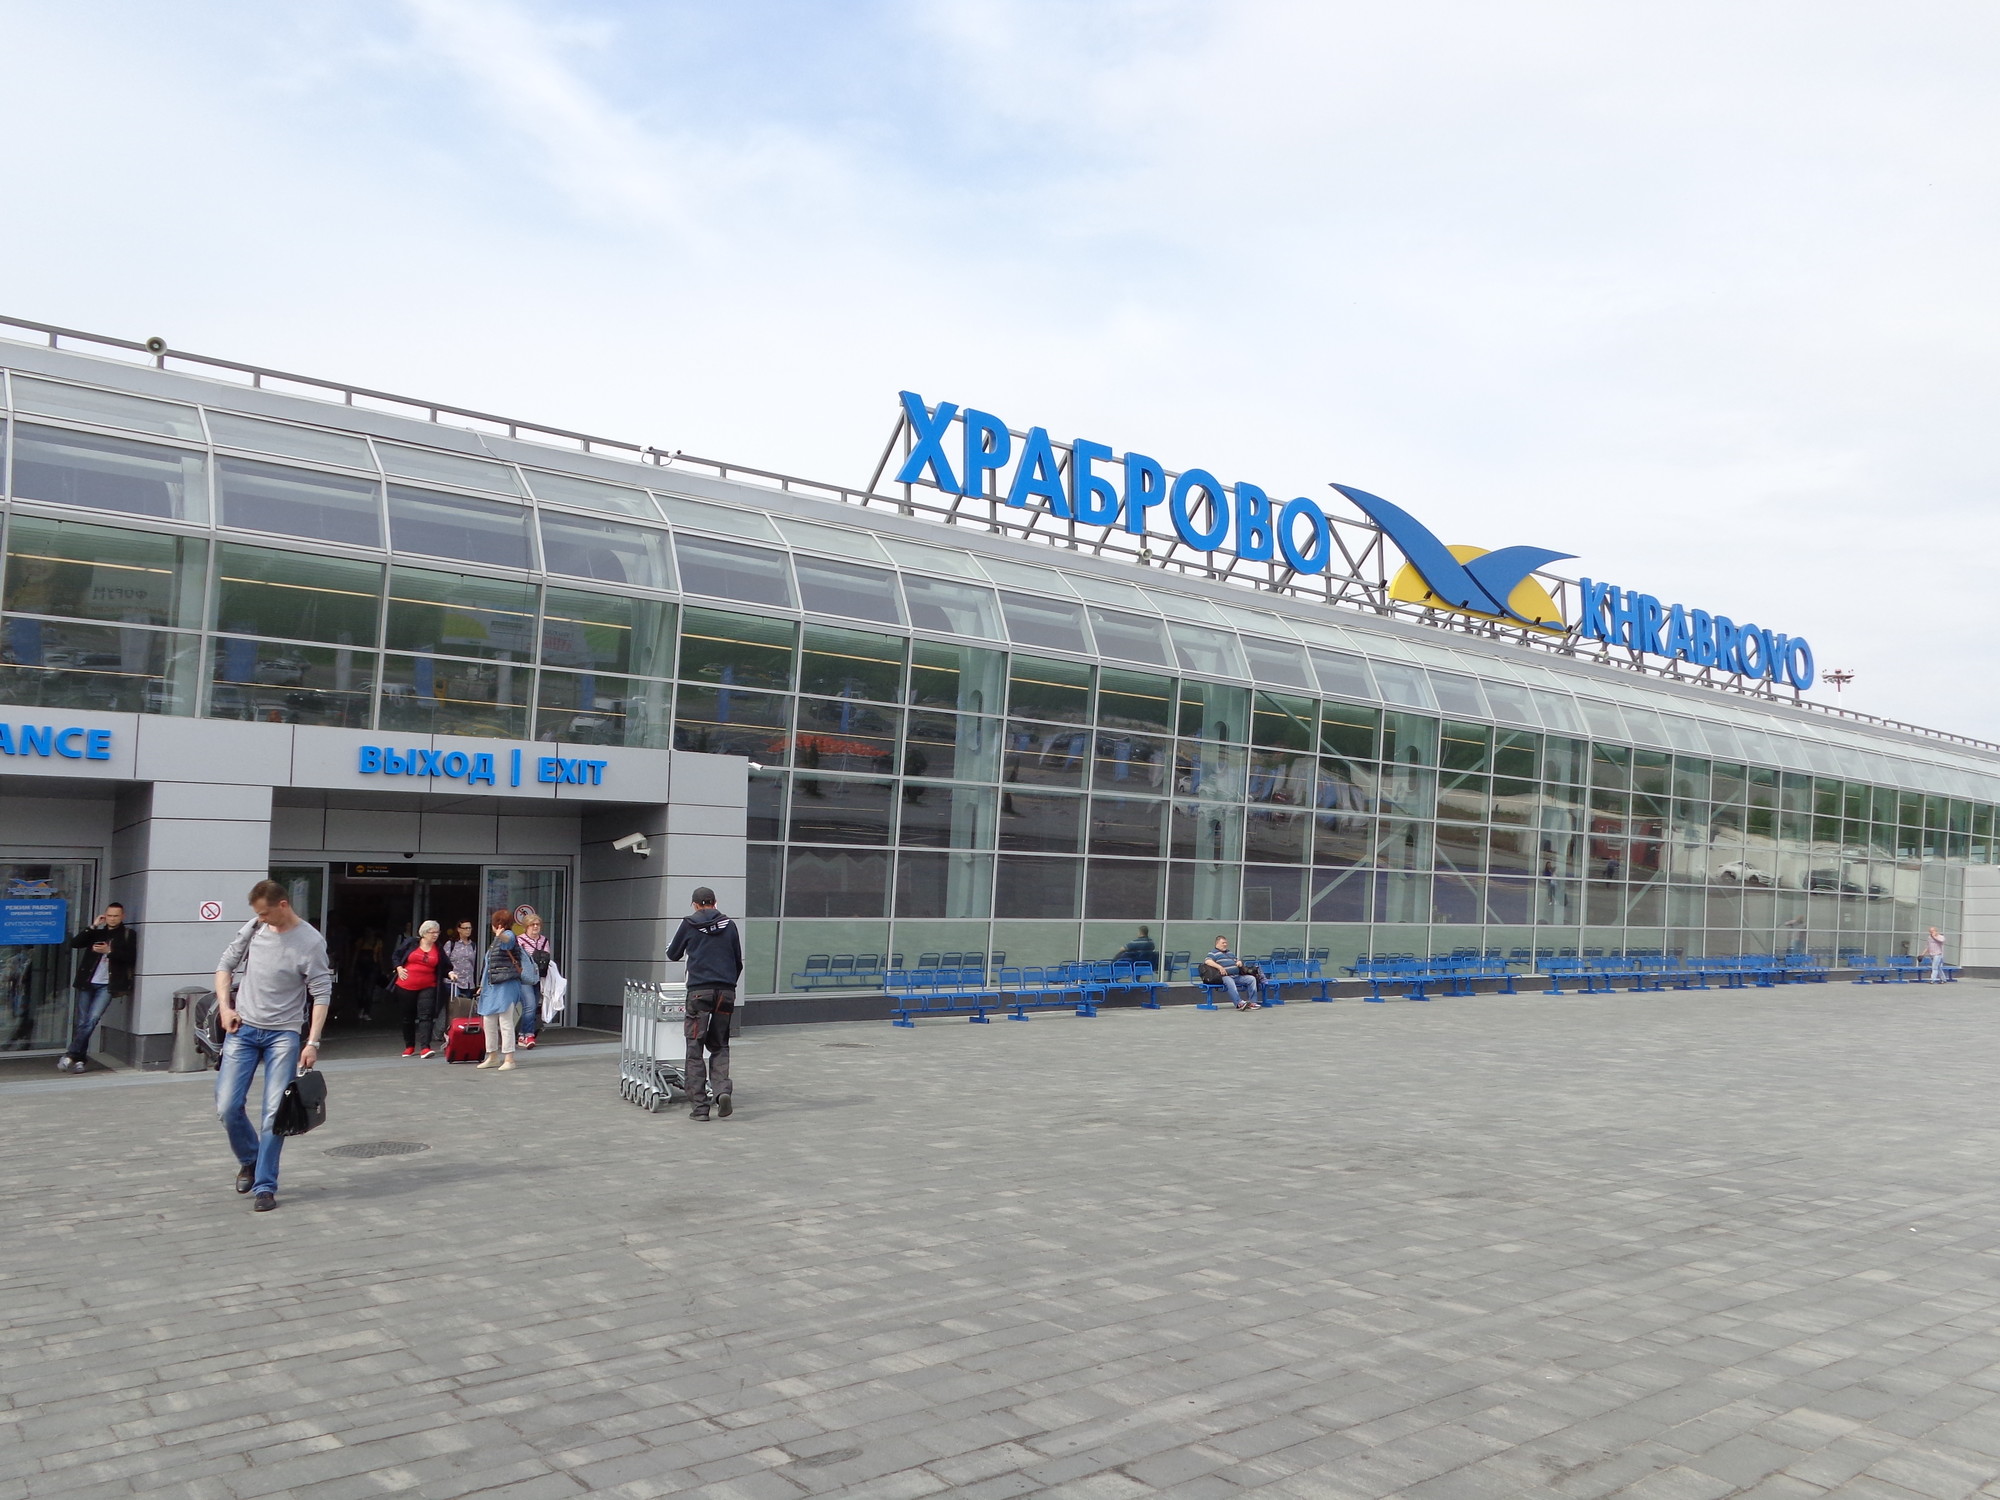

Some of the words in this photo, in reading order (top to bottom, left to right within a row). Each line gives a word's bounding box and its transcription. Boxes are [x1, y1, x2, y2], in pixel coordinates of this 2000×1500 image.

[894, 390, 1331, 574] ХРАБРОВО
[1580, 577, 1814, 690] KHRABROVO
[359, 746, 496, 786] ВЫХОД
[538, 757, 608, 785] EXIT
